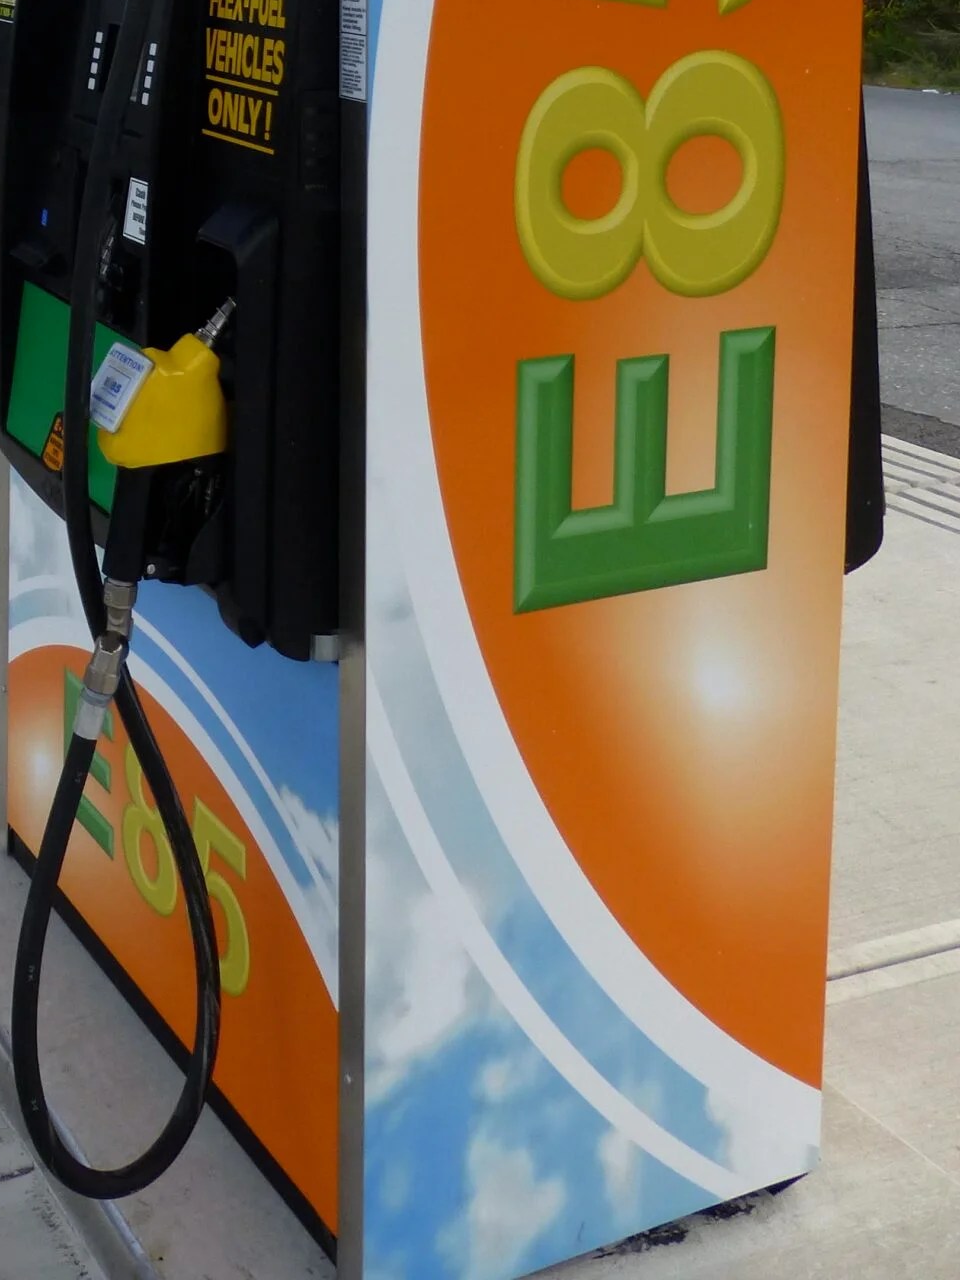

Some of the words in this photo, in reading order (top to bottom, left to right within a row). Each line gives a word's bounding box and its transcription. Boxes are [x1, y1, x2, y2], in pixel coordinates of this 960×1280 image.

[205, 27, 286, 85] VEHICLES
[208, 87, 273, 141] ONLY!
[63, 665, 250, 997] E85
